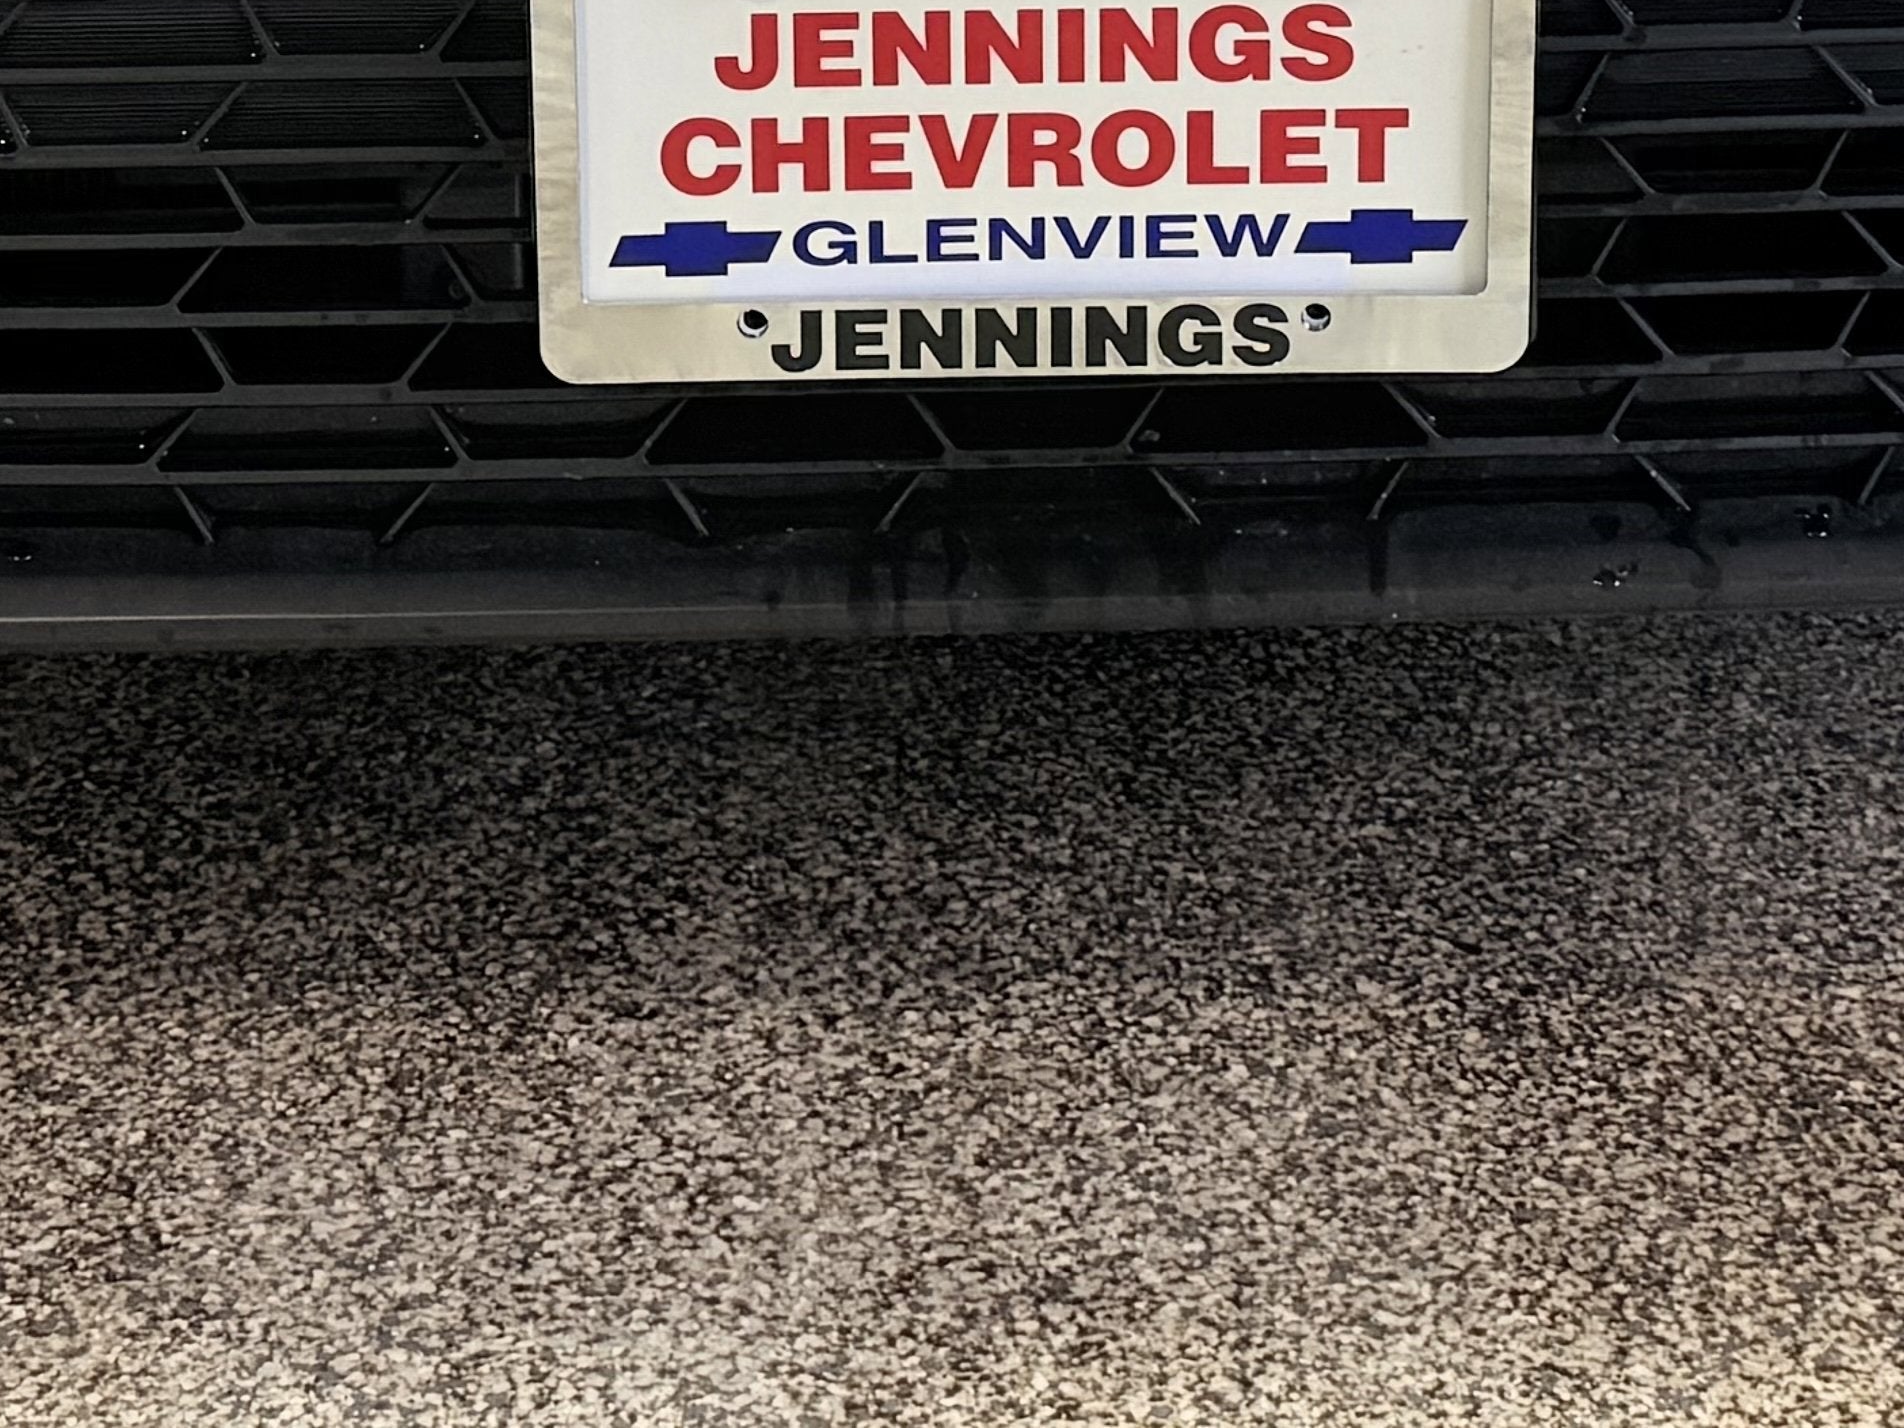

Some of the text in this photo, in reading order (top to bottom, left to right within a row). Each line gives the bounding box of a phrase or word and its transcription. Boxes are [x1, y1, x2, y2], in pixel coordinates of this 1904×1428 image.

[713, 3, 1356, 92] JENNINGS
[659, 107, 1411, 197] CHEVROLET
[792, 213, 1292, 267] GLENVIEW
[769, 301, 1293, 374] JENNINGS
